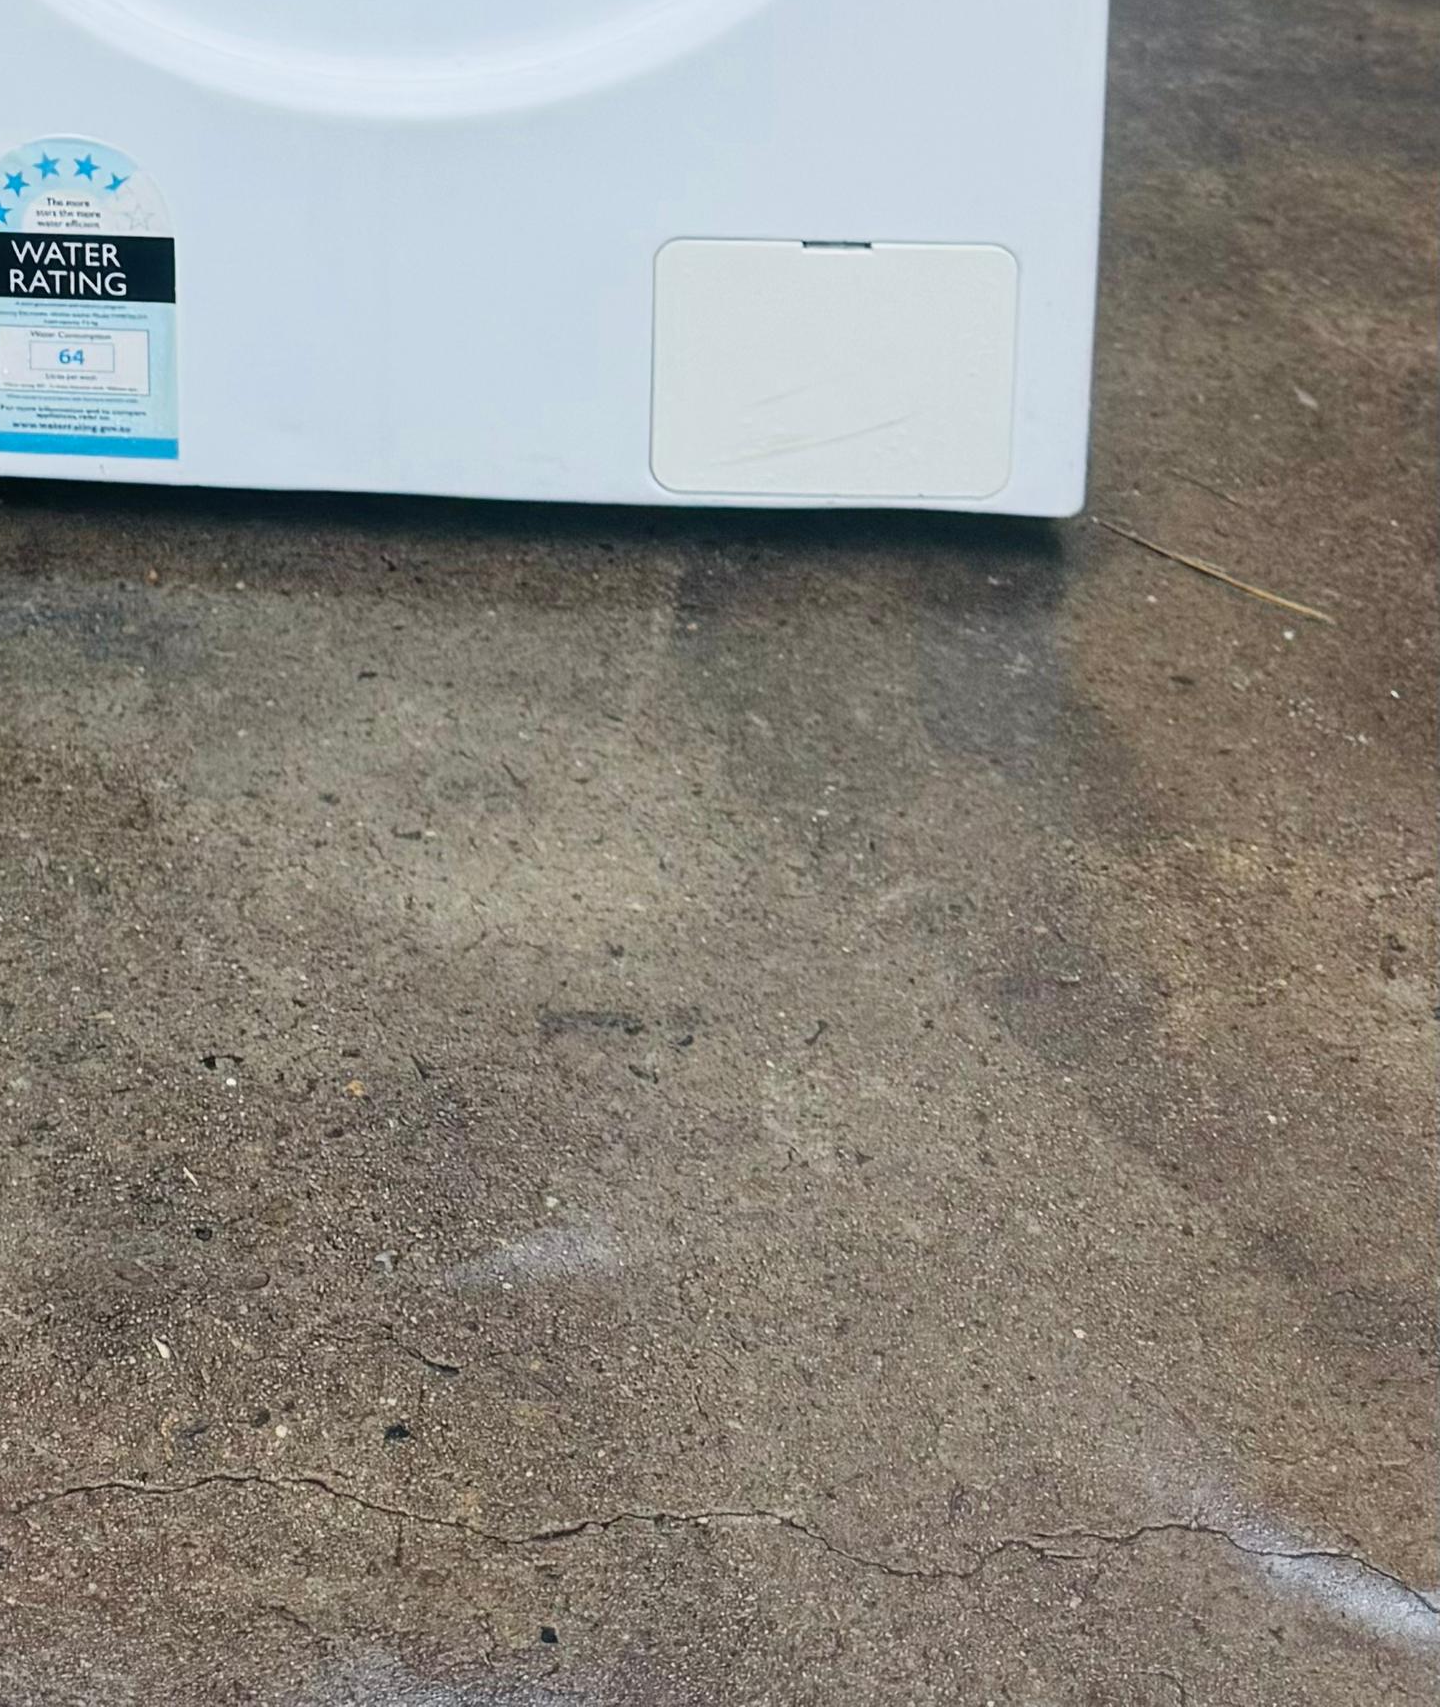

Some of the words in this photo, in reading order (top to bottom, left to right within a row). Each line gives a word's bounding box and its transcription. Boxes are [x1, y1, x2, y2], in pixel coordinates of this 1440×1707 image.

[47, 197, 63, 206] The
[11, 240, 121, 268] WATER
[10, 269, 127, 297] RATING
[58, 348, 85, 365] 64
